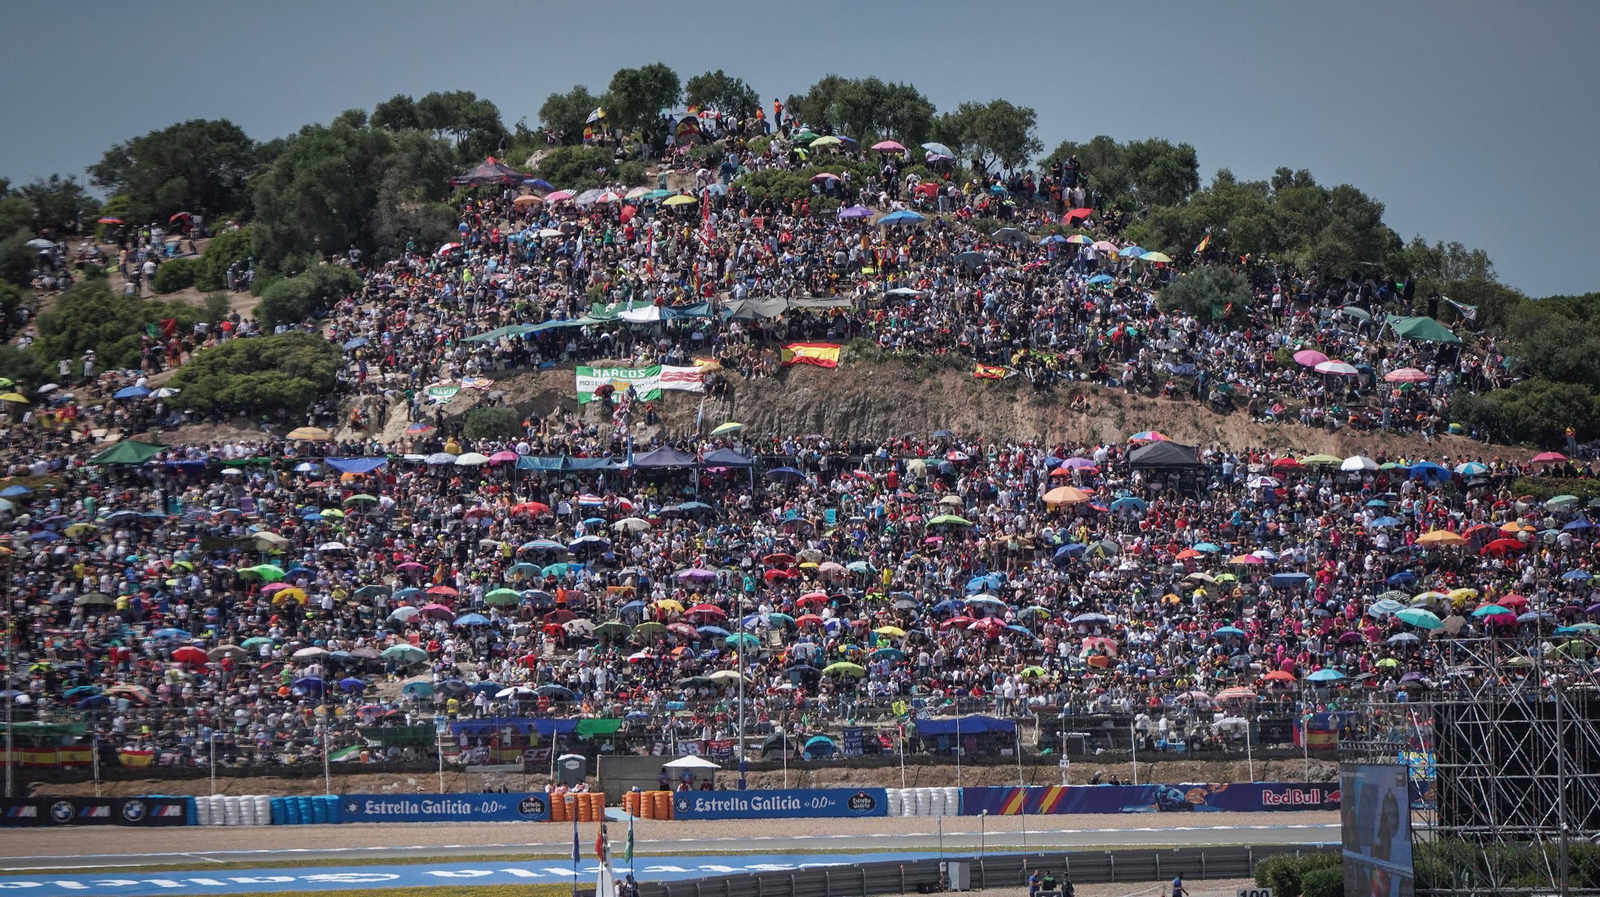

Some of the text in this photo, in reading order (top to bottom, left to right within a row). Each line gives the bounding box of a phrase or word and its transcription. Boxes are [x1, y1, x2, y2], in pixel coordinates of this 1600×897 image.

[593, 368, 646, 378] MARCOS
[523, 747, 552, 761] 93
[694, 797, 749, 812] Estrella
[750, 795, 801, 811] Galicia
[1262, 788, 1320, 805] Red Bull
[364, 800, 419, 815] Estrella
[420, 799, 472, 815] Galicia
